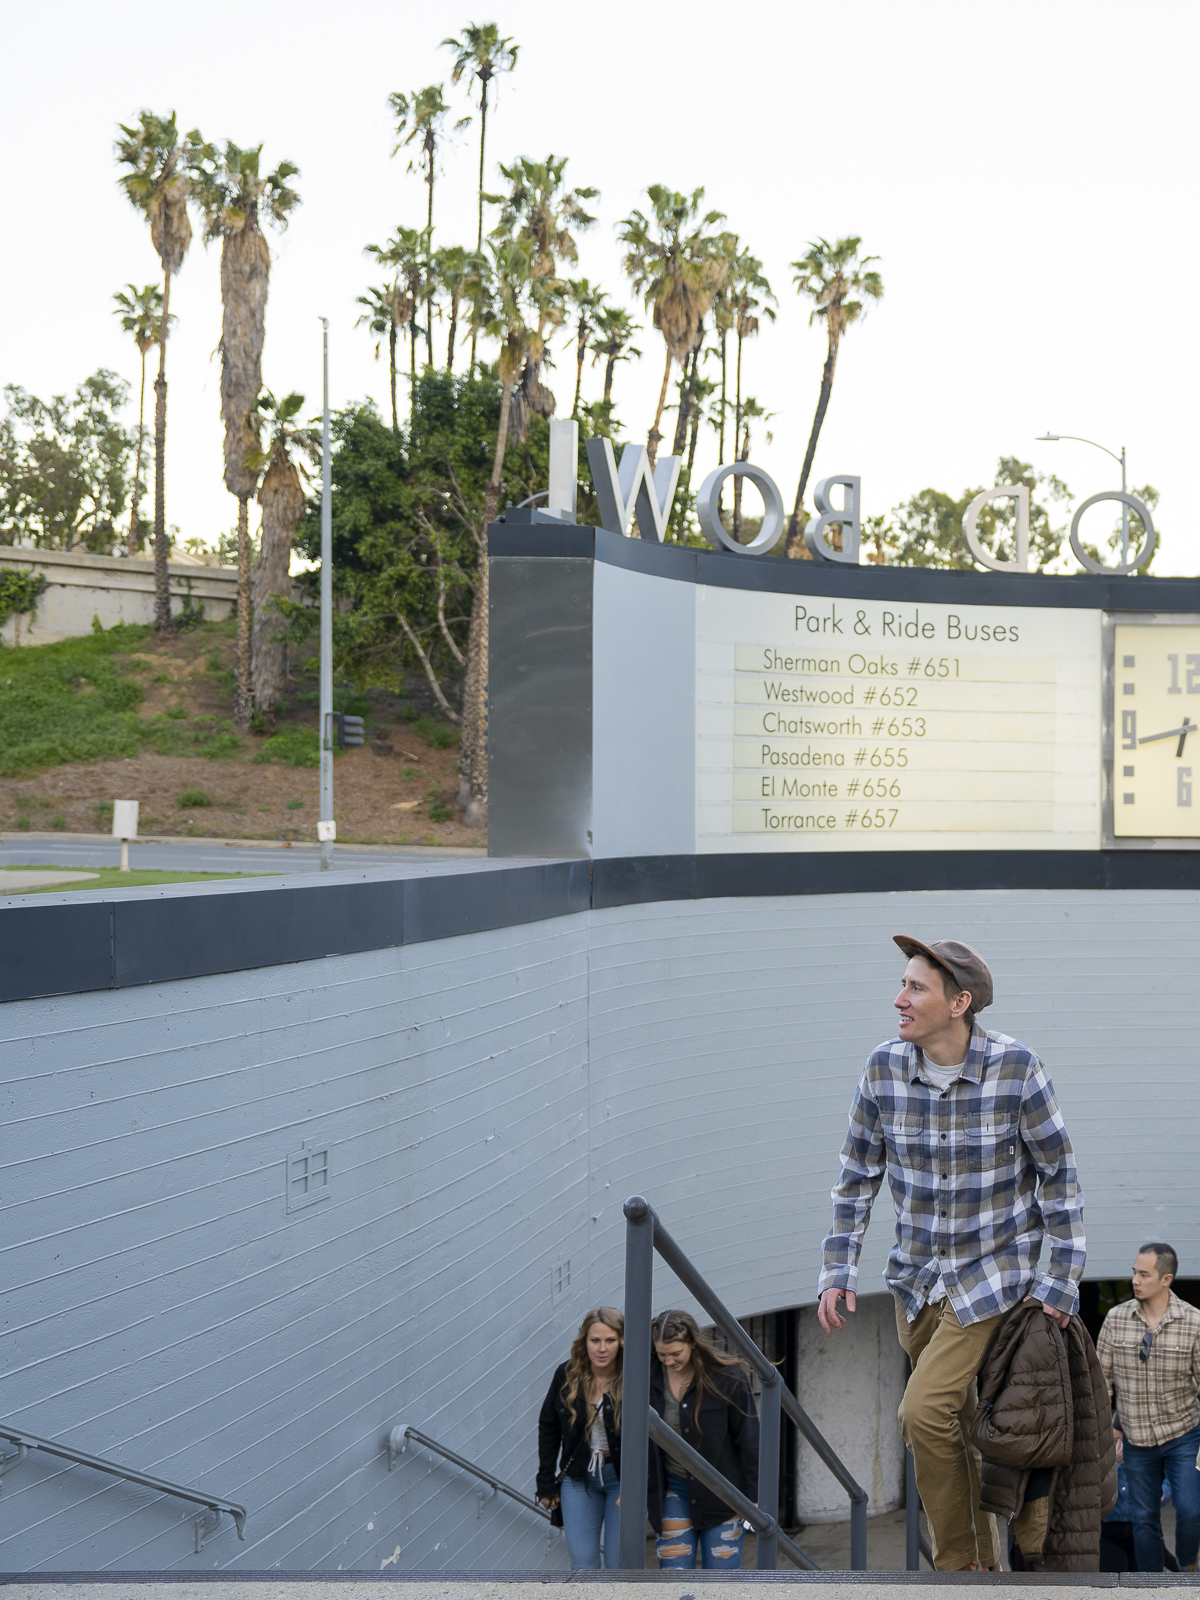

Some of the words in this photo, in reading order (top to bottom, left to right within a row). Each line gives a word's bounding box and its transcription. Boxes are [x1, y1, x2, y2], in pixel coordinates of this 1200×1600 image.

[794, 603, 843, 634] Park
[853, 610, 872, 635] &
[882, 608, 935, 640] Ride
[947, 614, 1019, 642] Buses
[763, 649, 840, 673] Sherman
[848, 653, 898, 676] Oaks
[907, 657, 961, 677] #651
[1168, 654, 1200, 693] 12
[764, 682, 854, 704] Westwood
[863, 687, 918, 707] #652
[763, 712, 862, 735] Chatsworth
[871, 717, 926, 737] #653
[1122, 710, 1136, 749] 9
[761, 745, 844, 766] Pasadena
[854, 748, 908, 767] #655
[761, 776, 775, 797] El
[782, 778, 838, 797] Monte
[847, 778, 900, 797] #656
[1177, 767, 1192, 807] 6
[761, 809, 836, 828] Torrance
[845, 809, 899, 828] #657
